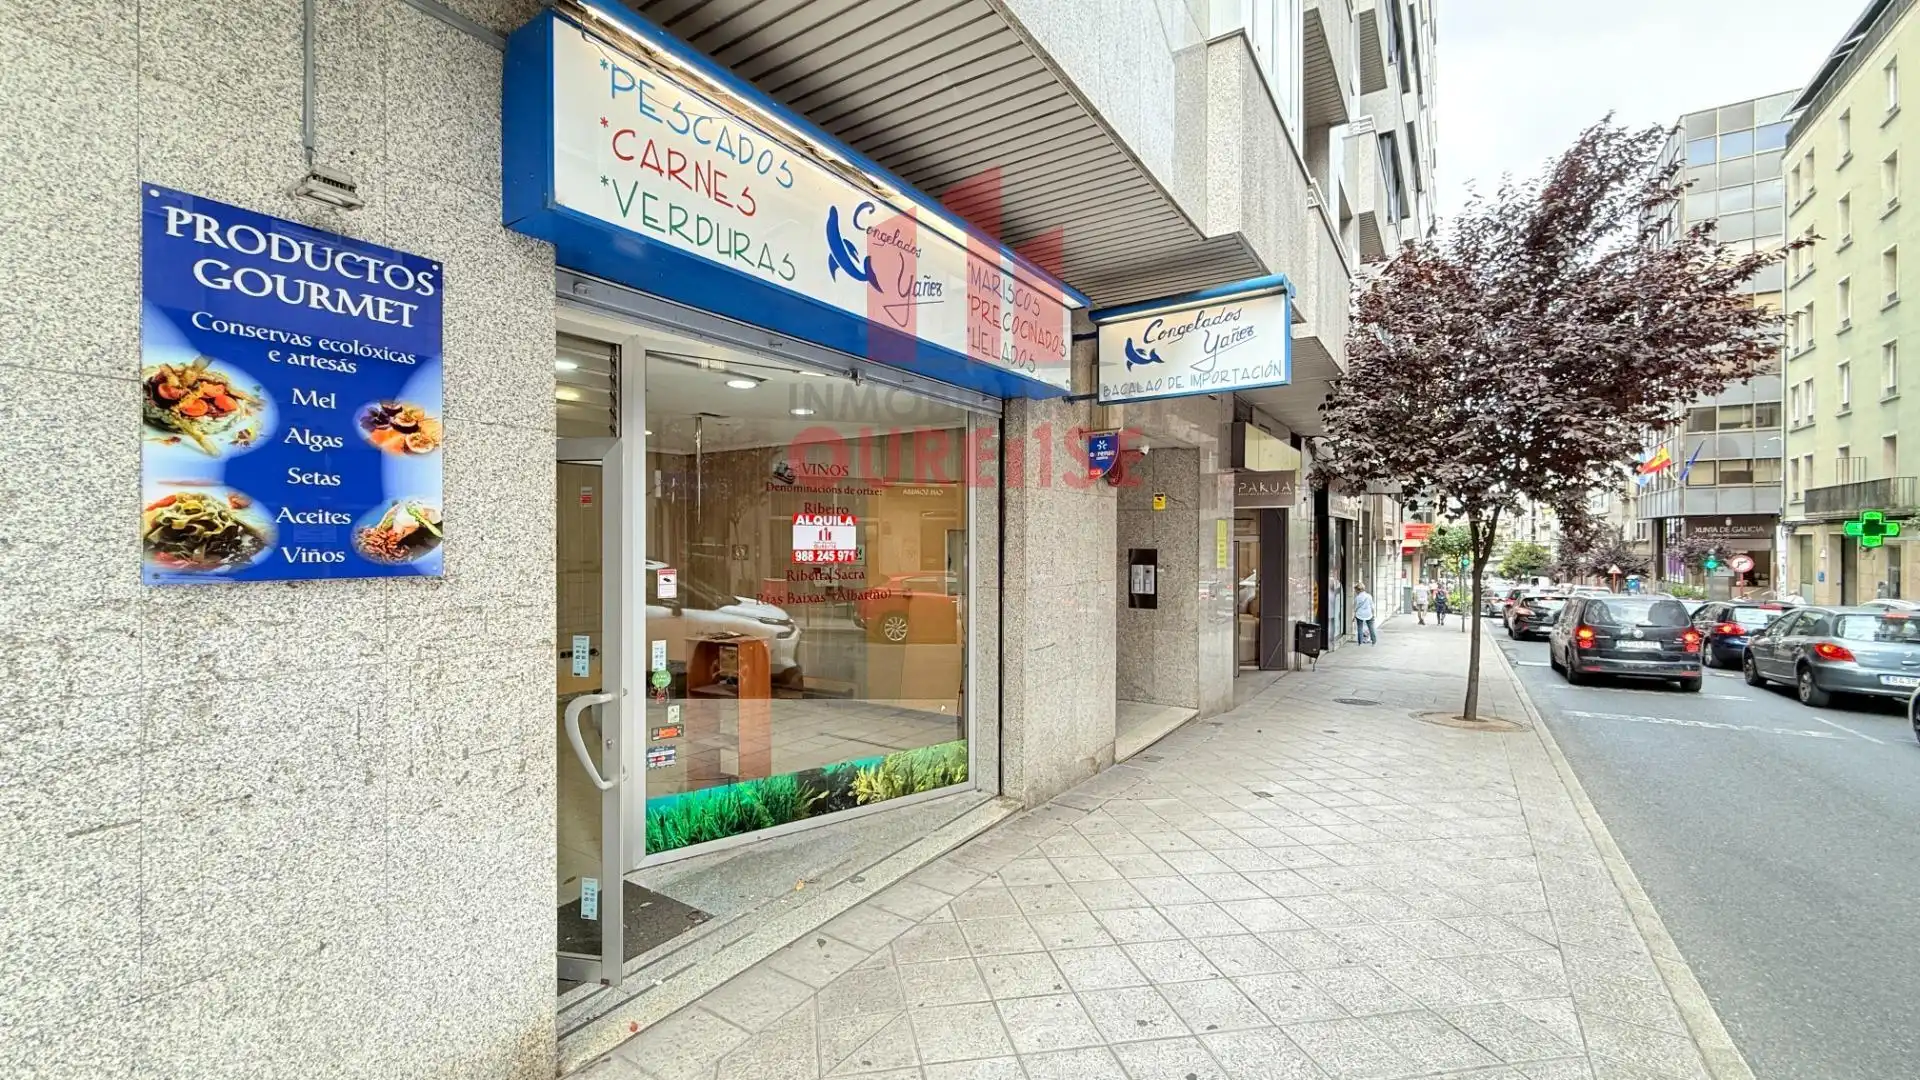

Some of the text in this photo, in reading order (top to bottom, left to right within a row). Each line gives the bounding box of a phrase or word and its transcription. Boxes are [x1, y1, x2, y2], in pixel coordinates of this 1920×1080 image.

[610, 63, 794, 189] PESCADOS
[612, 128, 757, 217] CARNES
[612, 178, 796, 281] VERDURAS
[853, 201, 922, 258] Congelados
[162, 205, 434, 297] PRODUCTOS
[193, 257, 419, 328] GOURMET
[882, 251, 945, 328] Yañez
[970, 264, 1041, 317] MARISCOS
[191, 311, 416, 365] Conservas ecolóxicas
[970, 295, 1067, 358] PRECOCINADOS
[1143, 307, 1243, 345] Congelados
[268, 347, 357, 375] e artesás
[971, 325, 1036, 374] HELADOS
[1103, 359, 1282, 398] BACALAO DE IMPORTACIÓN
[291, 387, 336, 410] Mel
[284, 427, 343, 453] Algas
[287, 467, 341, 487] Setas
[800, 461, 849, 477] VIÑOS
[844, 485, 856, 495] de
[1238, 481, 1292, 493] PAKUA
[275, 506, 352, 526] Aceites
[795, 515, 854, 526] ALQUILA
[804, 502, 849, 515] Ribeiro
[281, 546, 345, 564] Viños
[795, 550, 855, 562] 988 245 971
[834, 568, 865, 581] Sacra
[787, 591, 826, 604] Baixas
